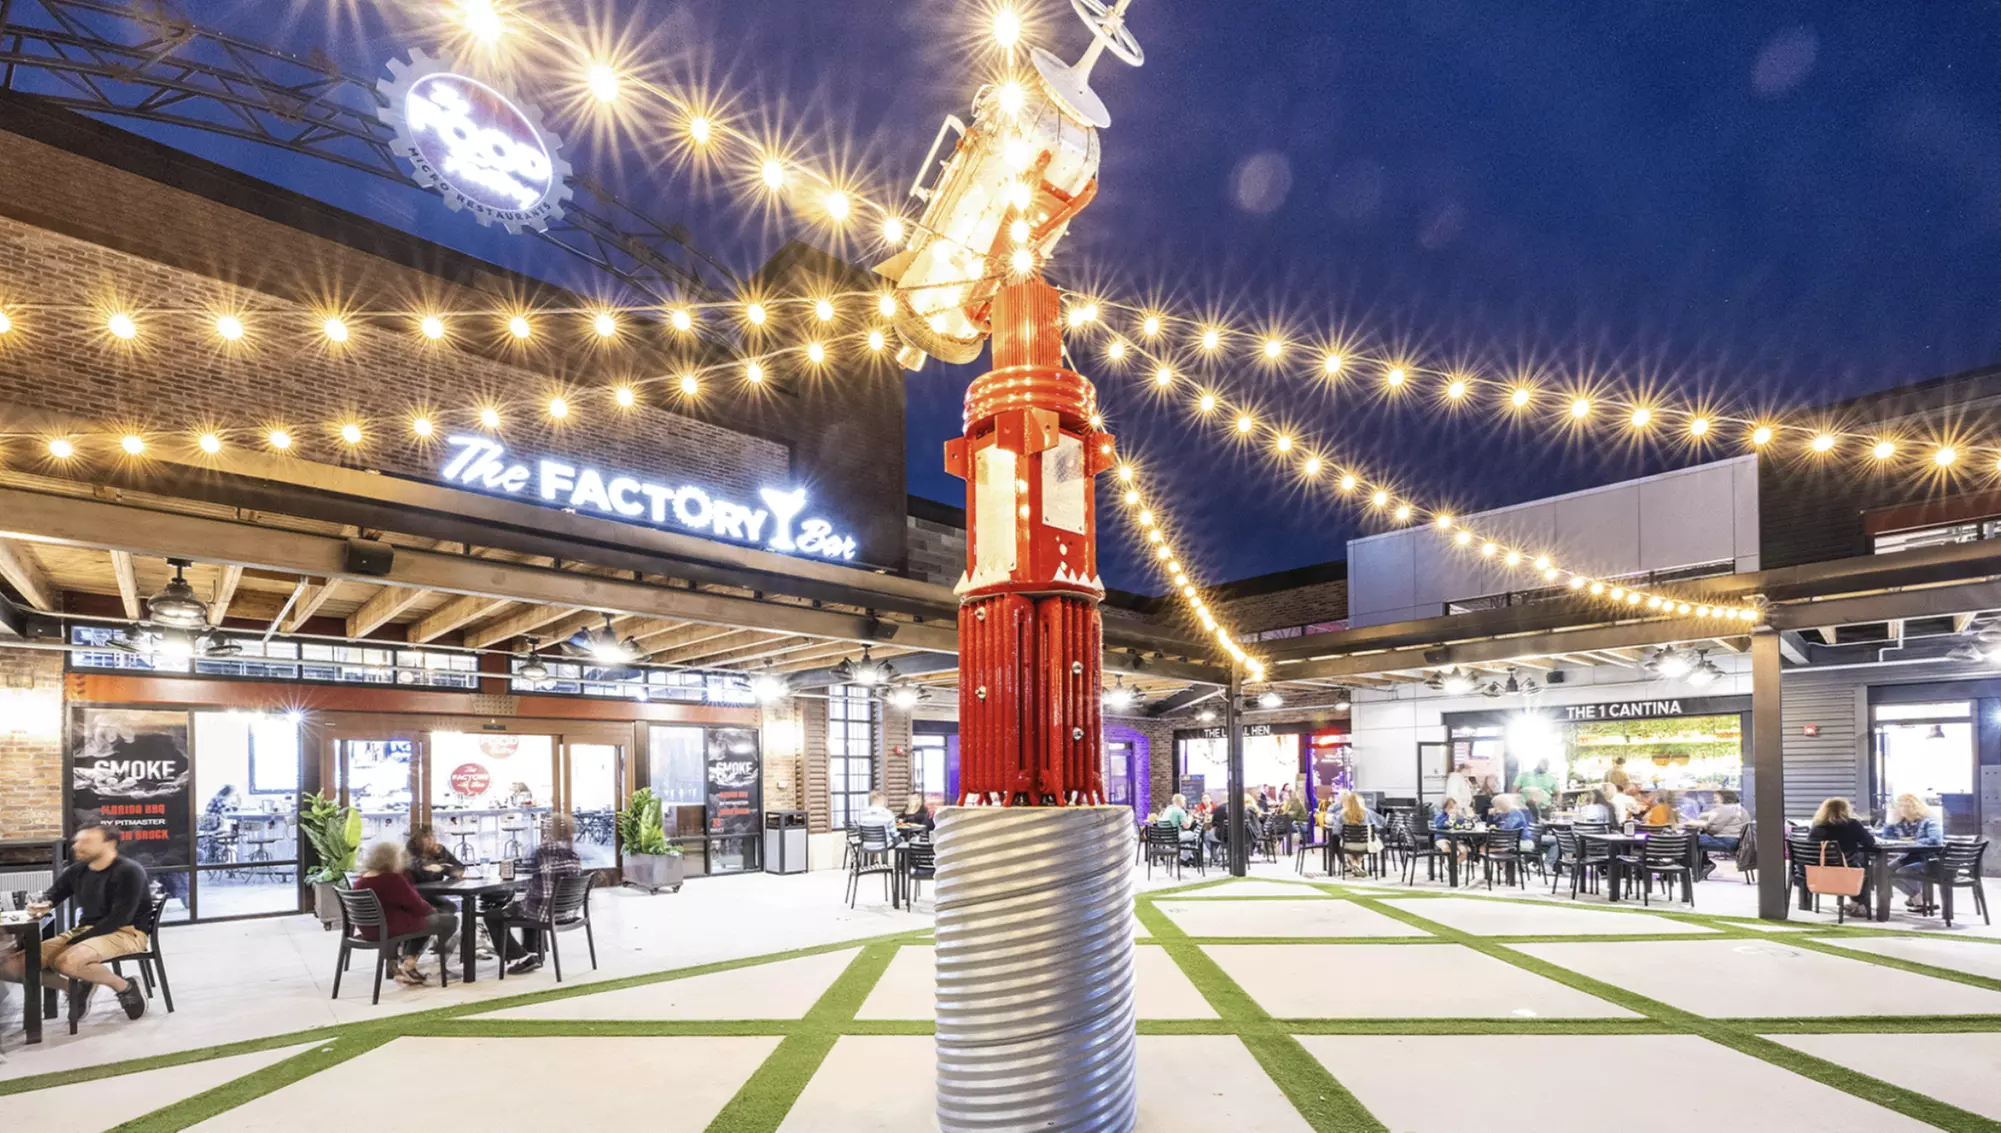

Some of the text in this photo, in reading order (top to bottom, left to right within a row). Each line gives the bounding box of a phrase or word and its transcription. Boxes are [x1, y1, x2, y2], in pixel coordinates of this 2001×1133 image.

[408, 147, 551, 220] MICRO RESTAURANTS
[442, 436, 857, 560] The FACTORY Bar
[1566, 700, 1682, 719] THE 1 CANTINA
[1204, 728, 1220, 738] THE
[1251, 725, 1271, 736] HEN
[94, 760, 176, 780] SMOKE
[716, 762, 752, 774] SMOKE
